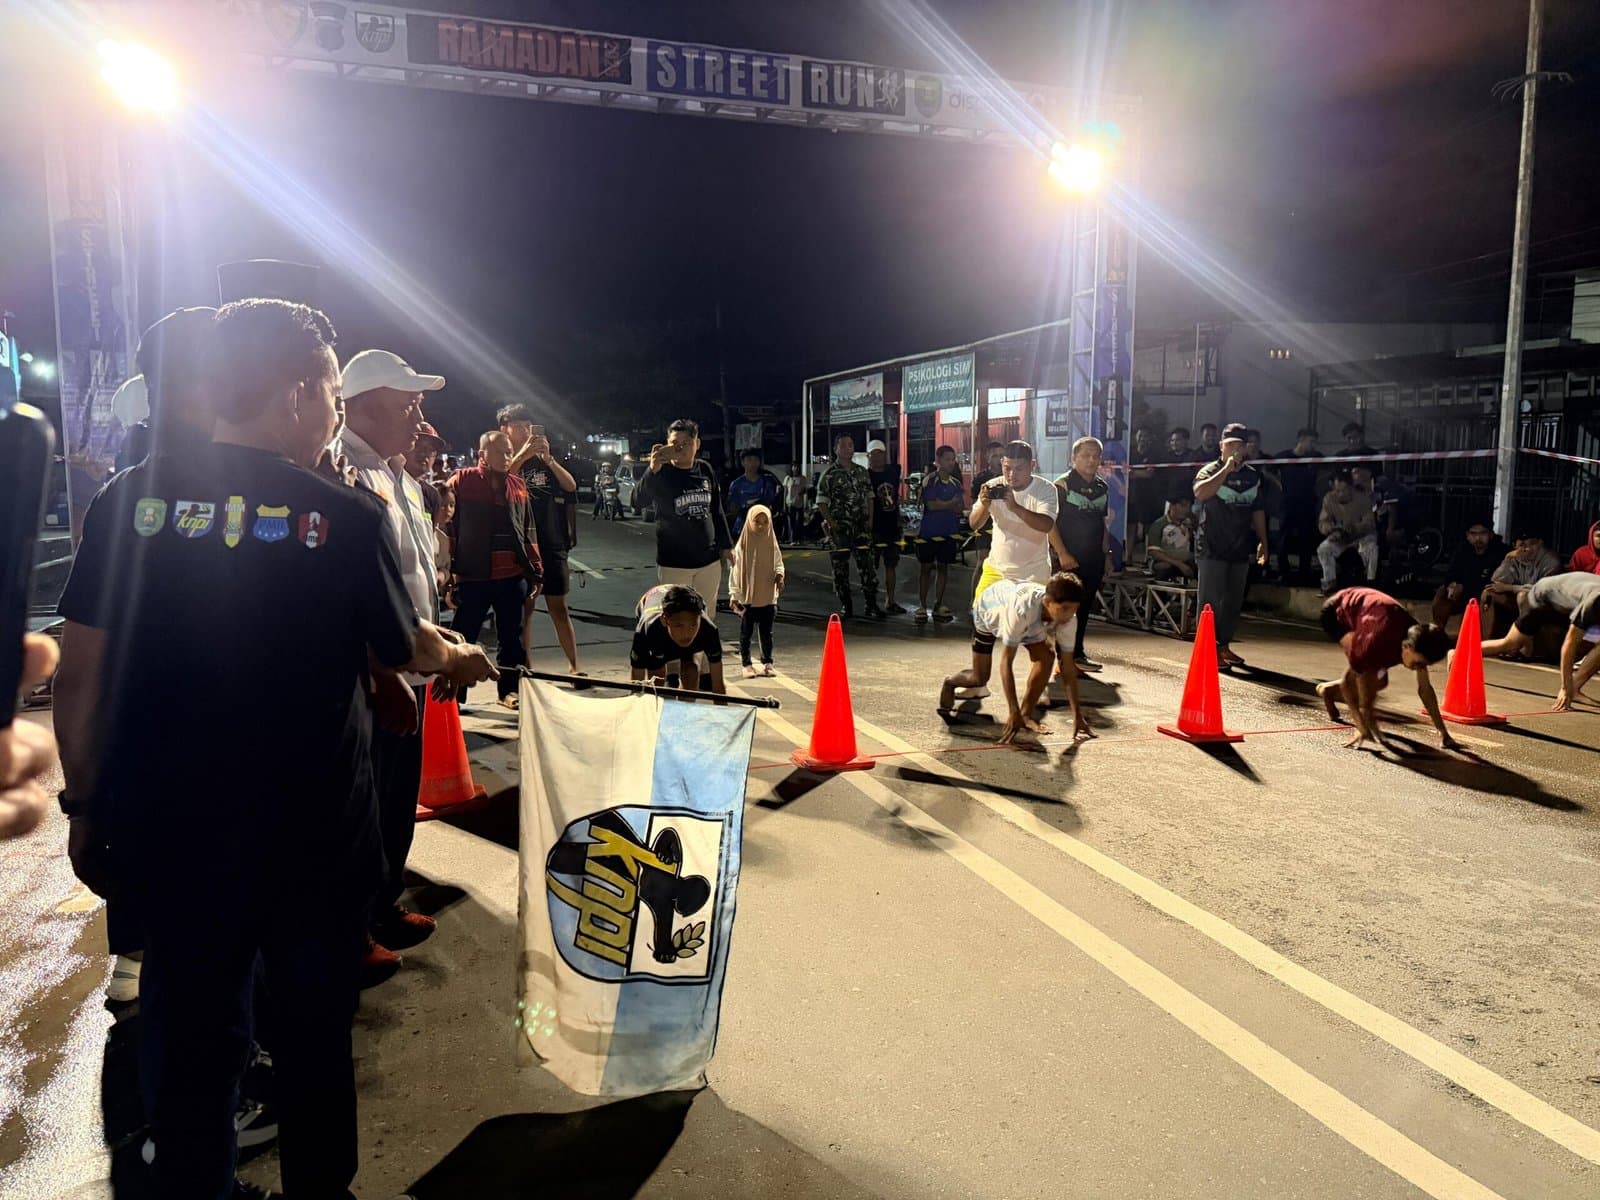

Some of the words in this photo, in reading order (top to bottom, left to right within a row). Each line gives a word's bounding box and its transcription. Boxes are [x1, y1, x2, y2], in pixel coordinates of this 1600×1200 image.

[438, 18, 600, 78] RAMADAN
[656, 45, 791, 100] STREET
[811, 63, 874, 108] RUN
[908, 363, 951, 383] PSIKOLOGI
[1106, 379, 1117, 439] RUN
[176, 510, 210, 538] knpi
